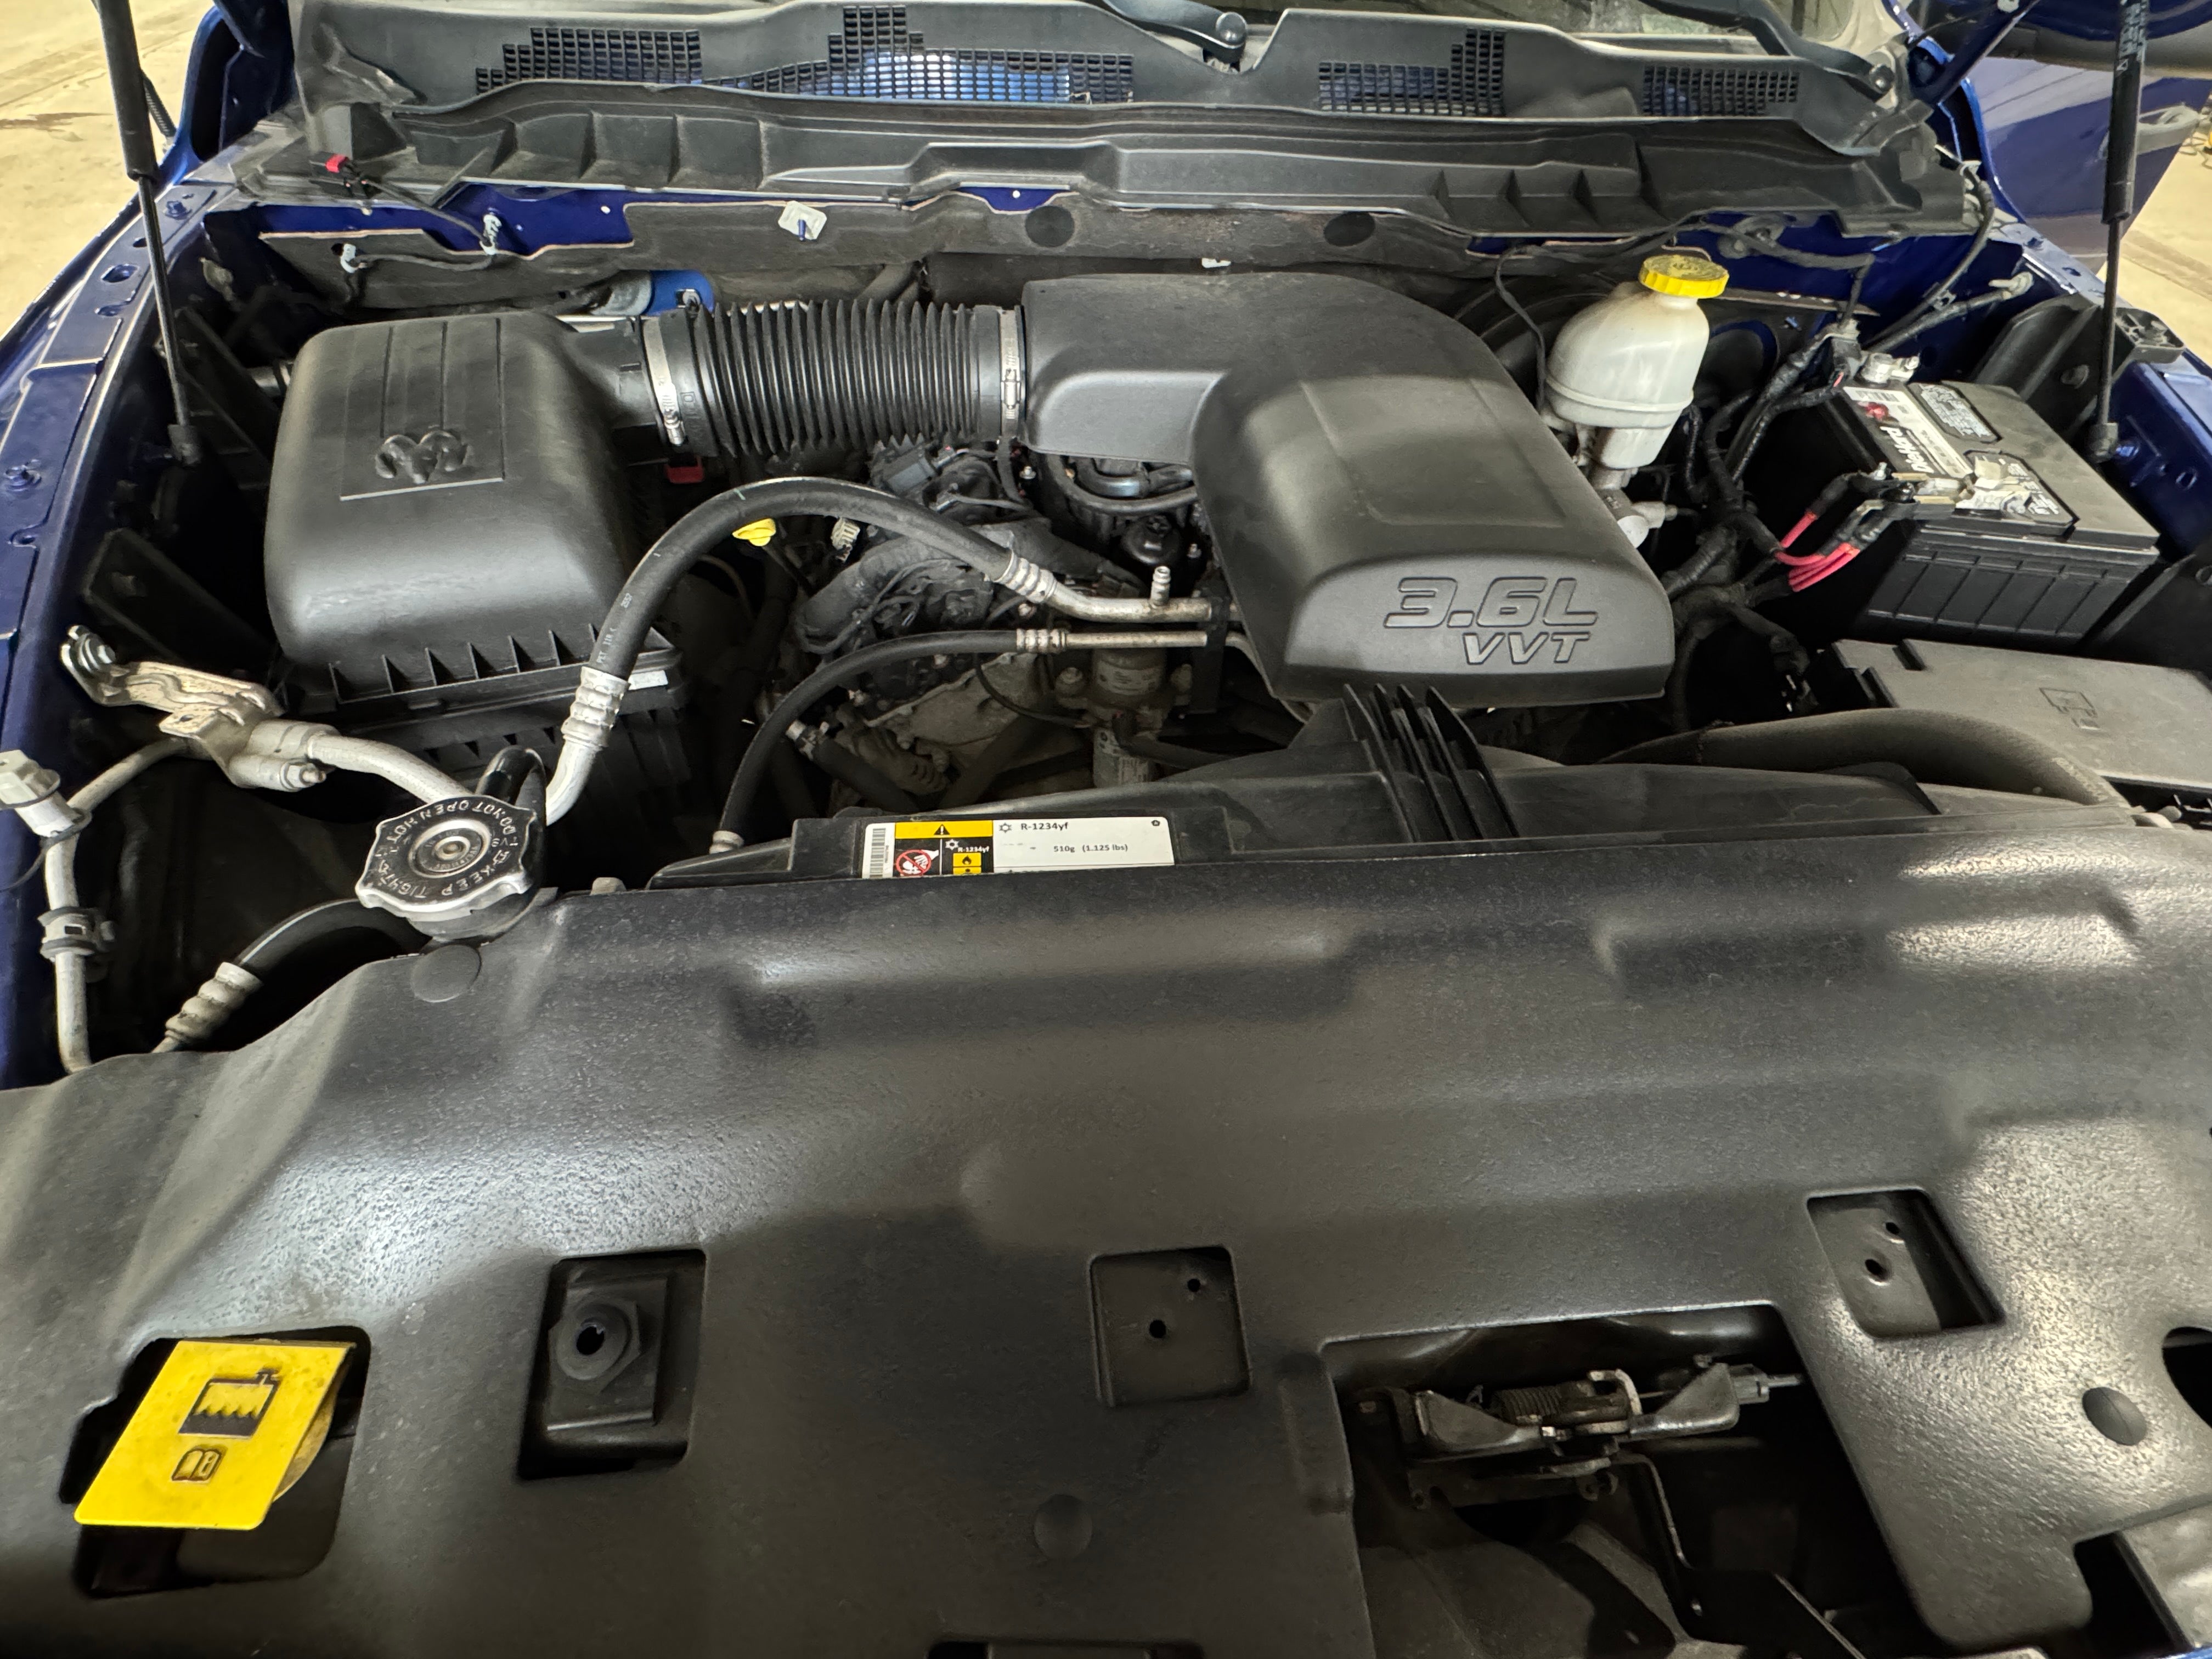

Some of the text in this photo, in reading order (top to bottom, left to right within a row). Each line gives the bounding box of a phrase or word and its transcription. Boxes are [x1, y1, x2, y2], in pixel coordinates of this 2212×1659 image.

[1880, 426, 1934, 473] DieHard
[1384, 577, 1598, 629] 3.6L
[1462, 631, 1591, 665] VVT
[419, 799, 470, 820] OPEN
[1020, 822, 1069, 831] R-1234yf
[957, 845, 990, 854] R-1234yf
[1053, 845, 1075, 853] 510g
[1112, 843, 1128, 852] lbs)
[441, 865, 495, 896] KEEP
